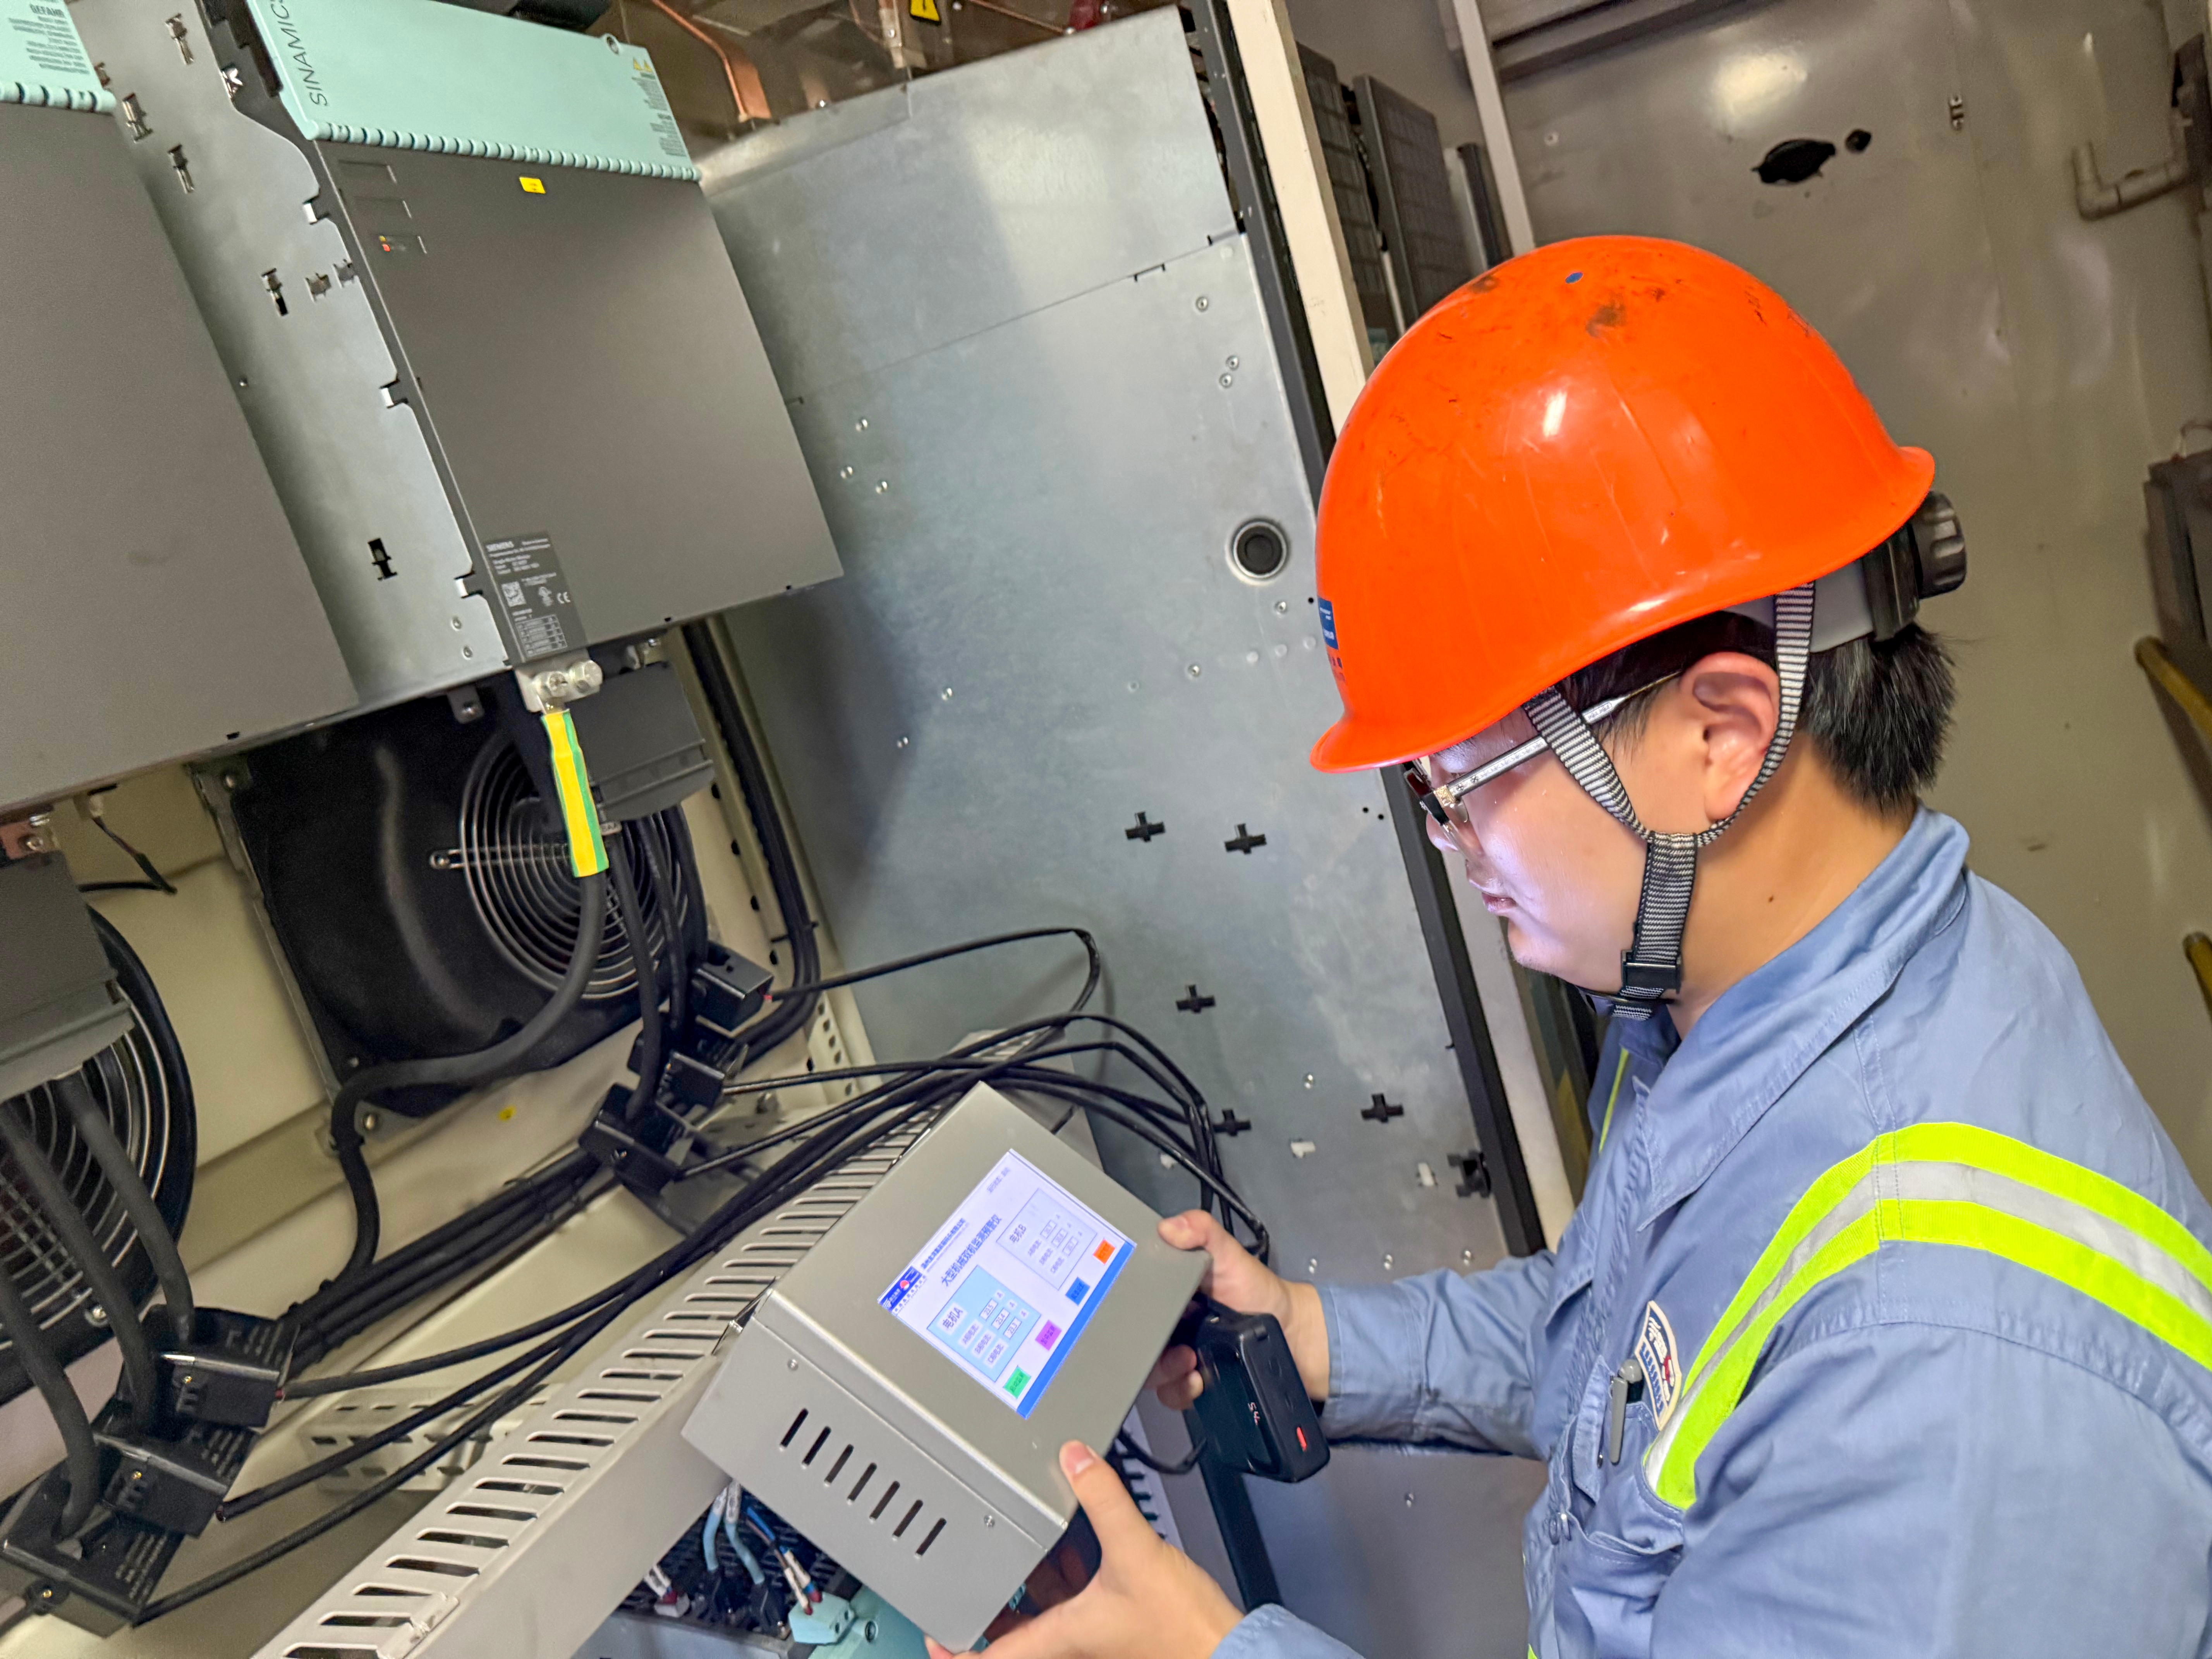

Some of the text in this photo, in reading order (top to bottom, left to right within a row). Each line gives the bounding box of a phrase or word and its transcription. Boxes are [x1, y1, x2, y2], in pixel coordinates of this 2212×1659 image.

[271, 0, 328, 106] SINAMIC
[940, 1215, 1001, 1285] 大型机械双机监测预警仪
[1008, 1224, 1027, 1243] 电机B
[942, 1306, 963, 1329] 电机A
